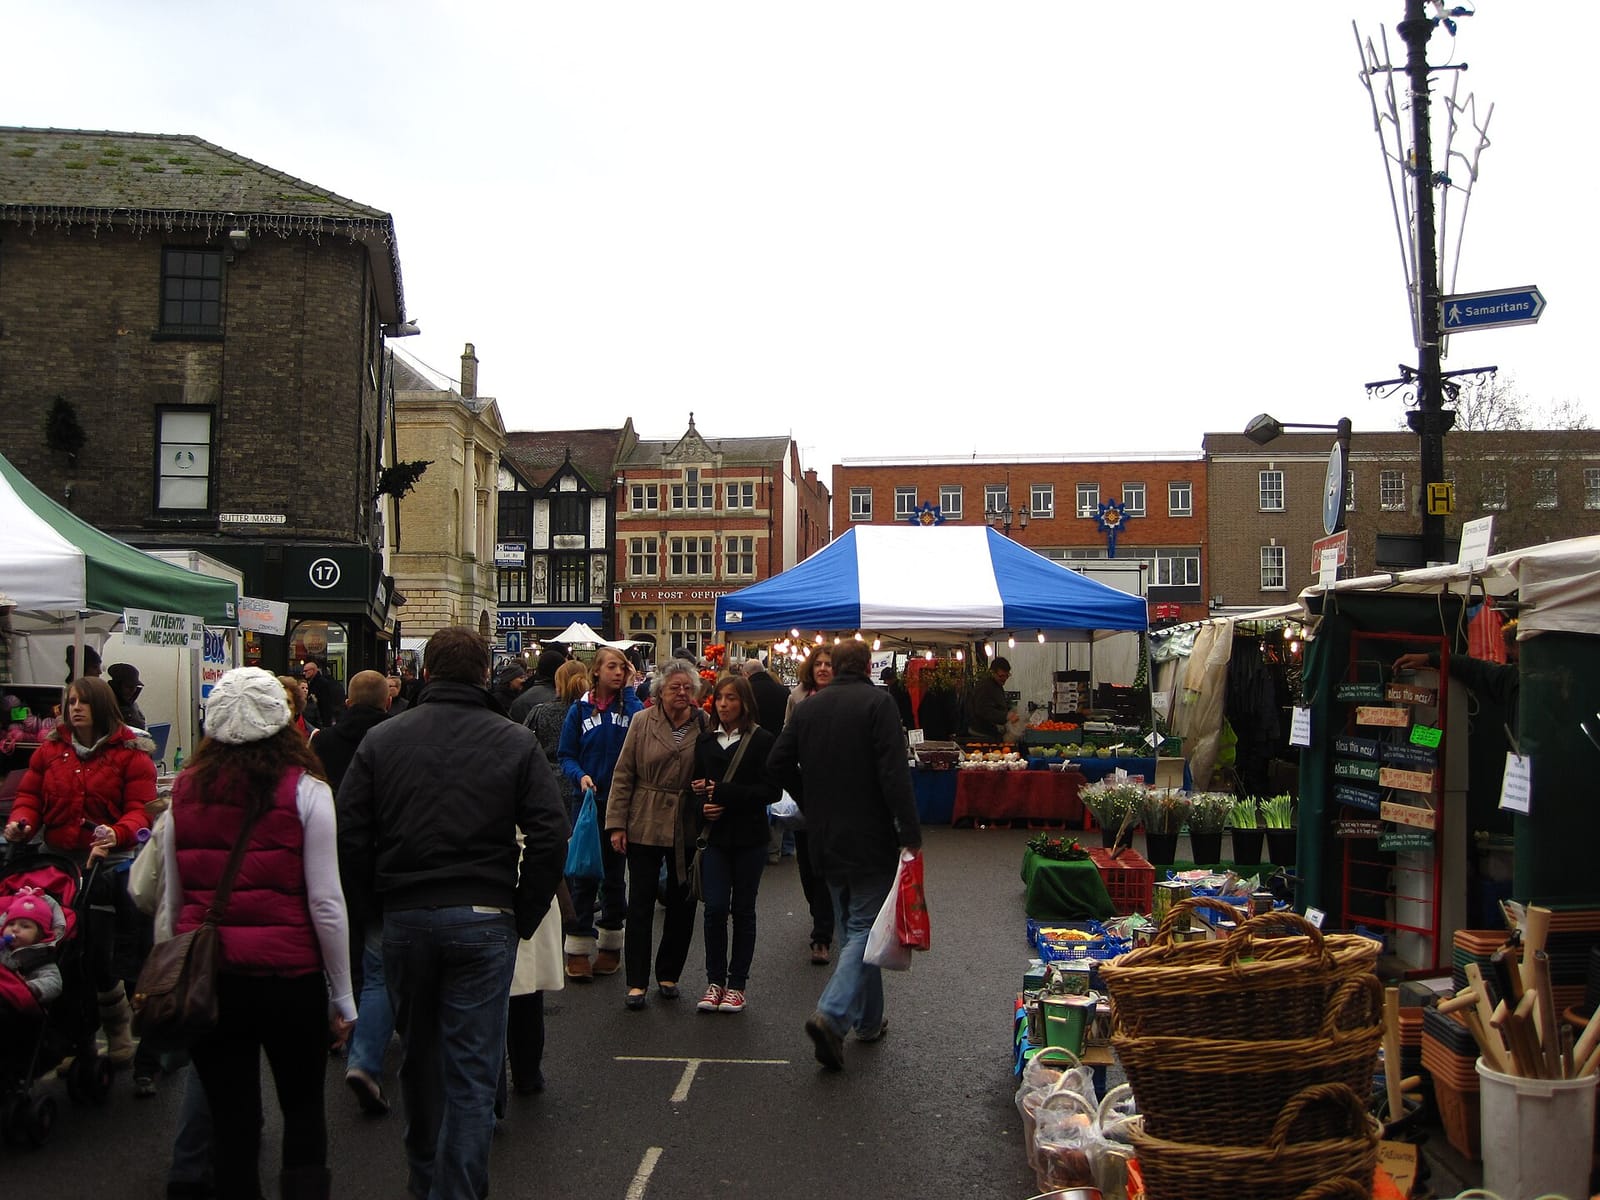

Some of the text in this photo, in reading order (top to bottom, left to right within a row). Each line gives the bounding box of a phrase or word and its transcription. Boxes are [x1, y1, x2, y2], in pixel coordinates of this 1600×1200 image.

[1465, 301, 1529, 317] Samaritans
[221, 514, 284, 523] BUTTER MARKET
[315, 566, 334, 581] 17
[658, 591, 684, 599] POST
[128, 615, 139, 626] FREE
[143, 629, 189, 646] HOME COOKING
[203, 631, 225, 664] BOX
[1349, 763, 1359, 775] this
